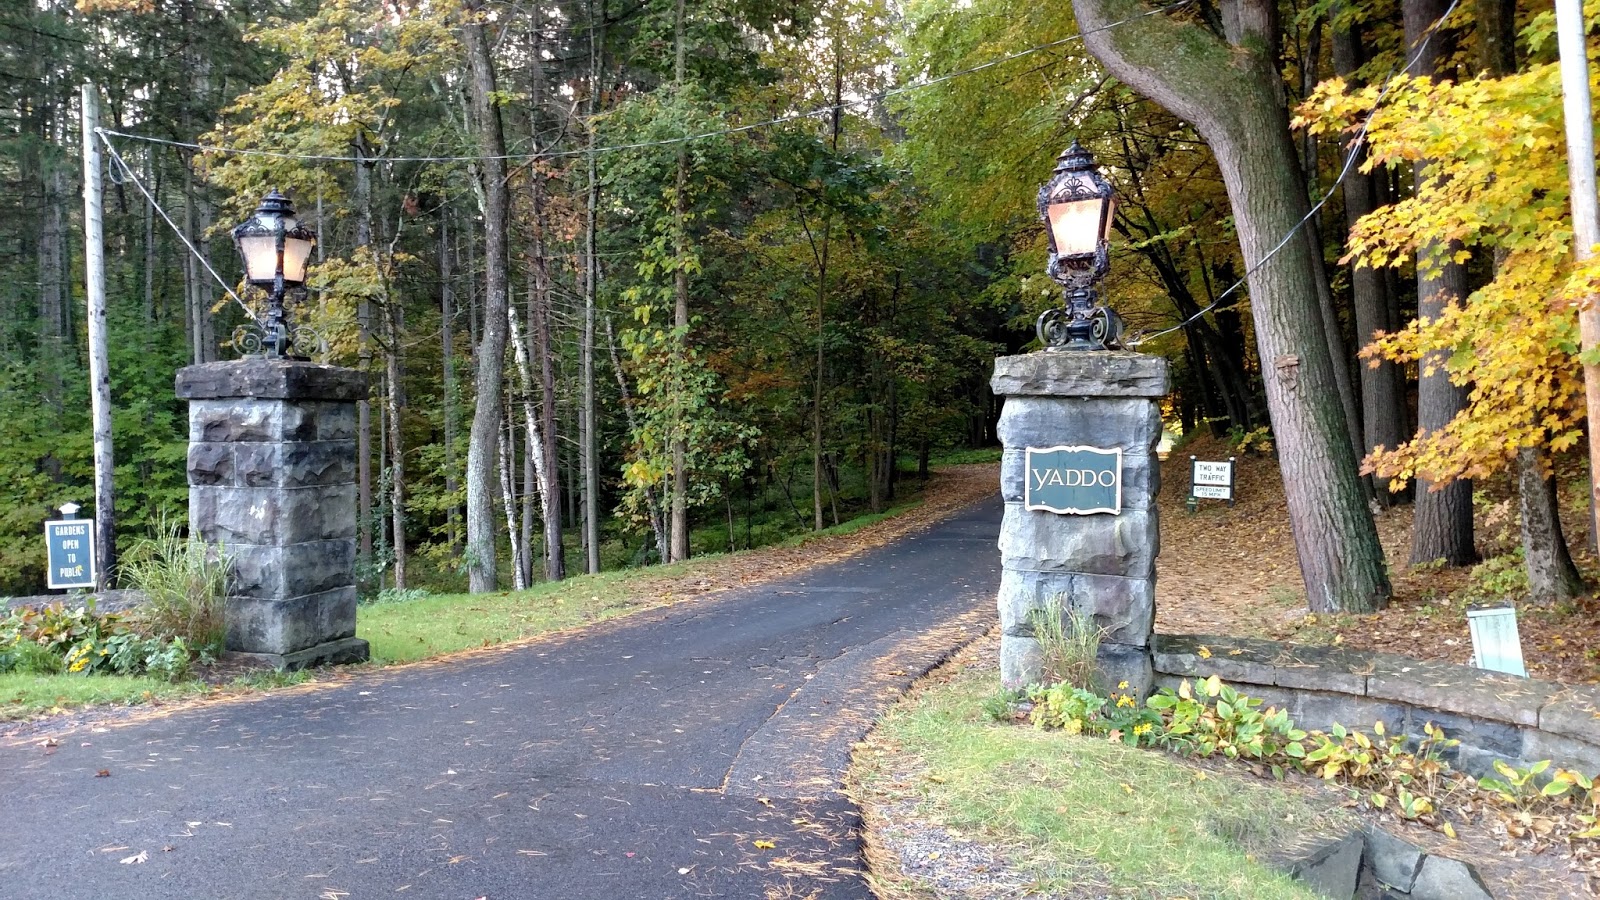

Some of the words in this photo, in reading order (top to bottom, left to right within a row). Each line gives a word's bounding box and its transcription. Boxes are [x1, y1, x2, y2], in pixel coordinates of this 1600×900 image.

[1031, 468, 1116, 491] YADDO
[1200, 474, 1225, 482] TRAFFIC
[55, 526, 85, 536] GARDENS
[62, 540, 79, 550] OPEN
[68, 553, 76, 564] TO
